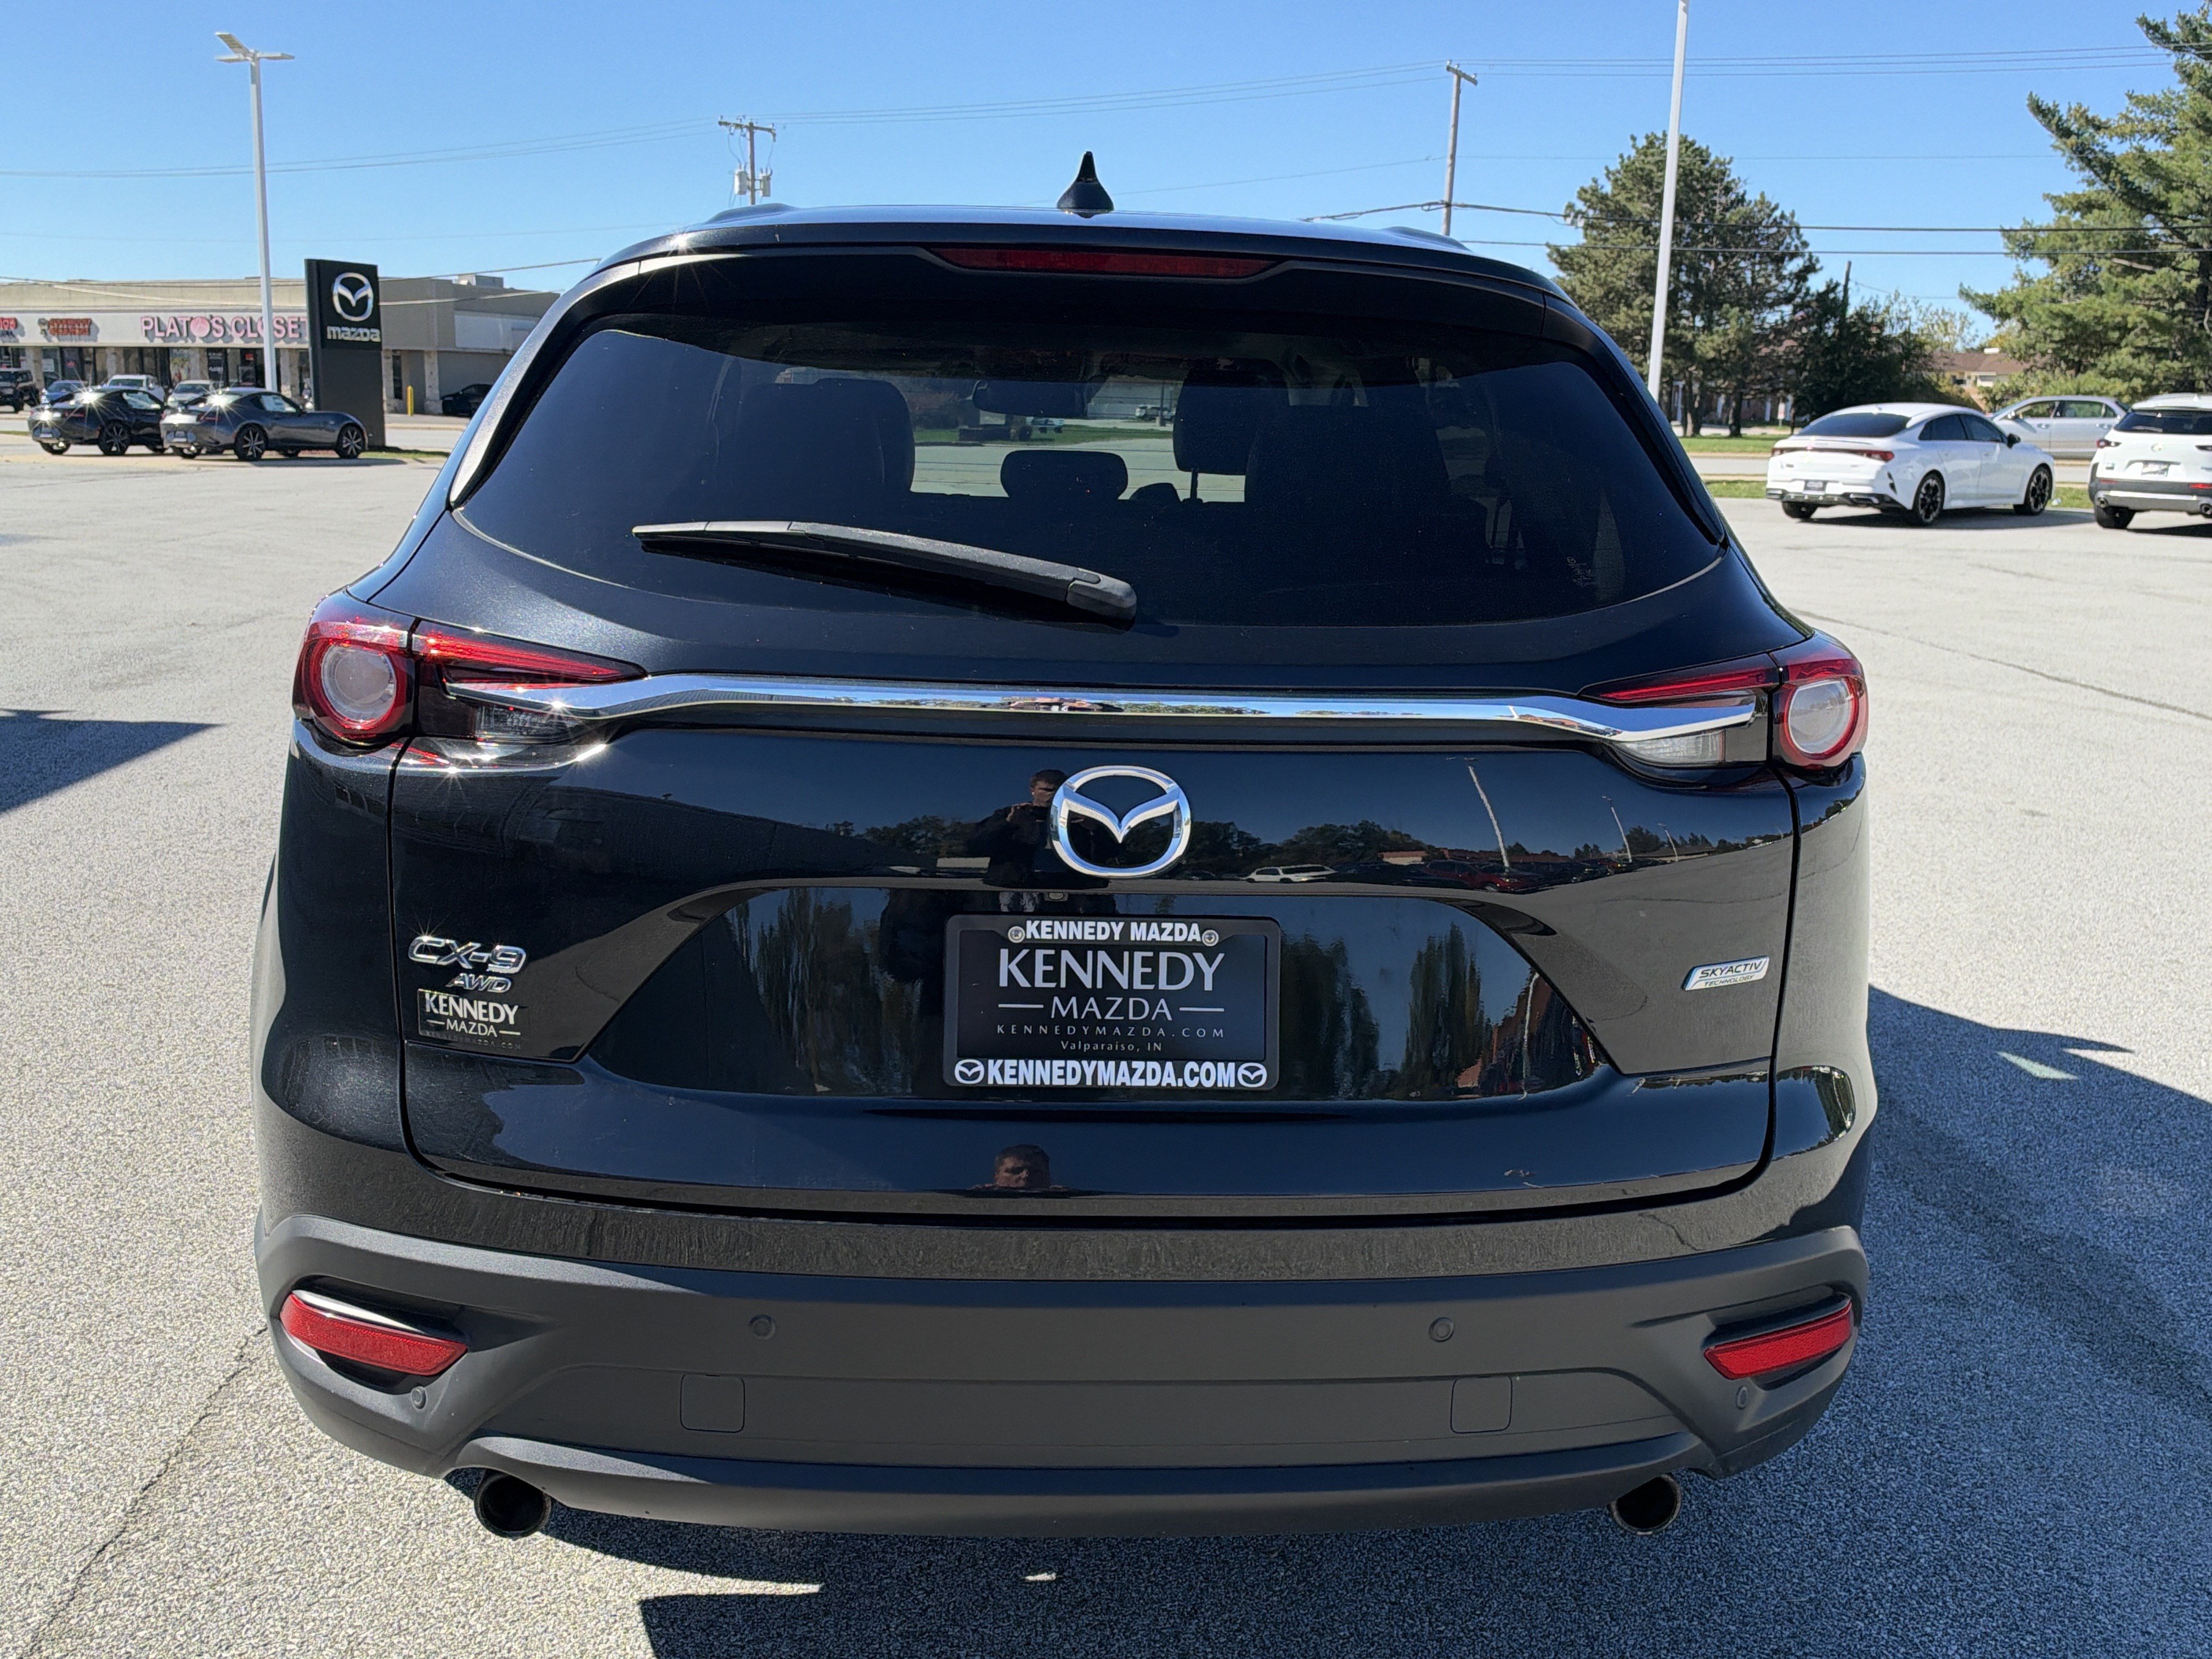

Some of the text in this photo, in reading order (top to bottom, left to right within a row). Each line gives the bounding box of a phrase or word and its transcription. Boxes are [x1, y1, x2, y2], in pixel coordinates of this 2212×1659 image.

[326, 326, 381, 342] mazda
[1026, 920, 1201, 943] KENNEDY MAZDA
[408, 936, 527, 974] CX-9
[998, 948, 1225, 991] KENNEDY
[1699, 961, 1762, 979] SKYACTIV
[445, 973, 512, 993] AWD
[1705, 974, 1755, 987] TECHNOLOGY
[424, 992, 519, 1025] KENNEDY
[1051, 996, 1173, 1021] MAZDA
[445, 1018, 498, 1038] MAZDA
[997, 1024, 1224, 1038] KENNEDYMAZDA.COM
[1060, 1040, 1162, 1052] Valparaiso, IN
[988, 1059, 1236, 1088] KENNEDYMAZDA.COM
